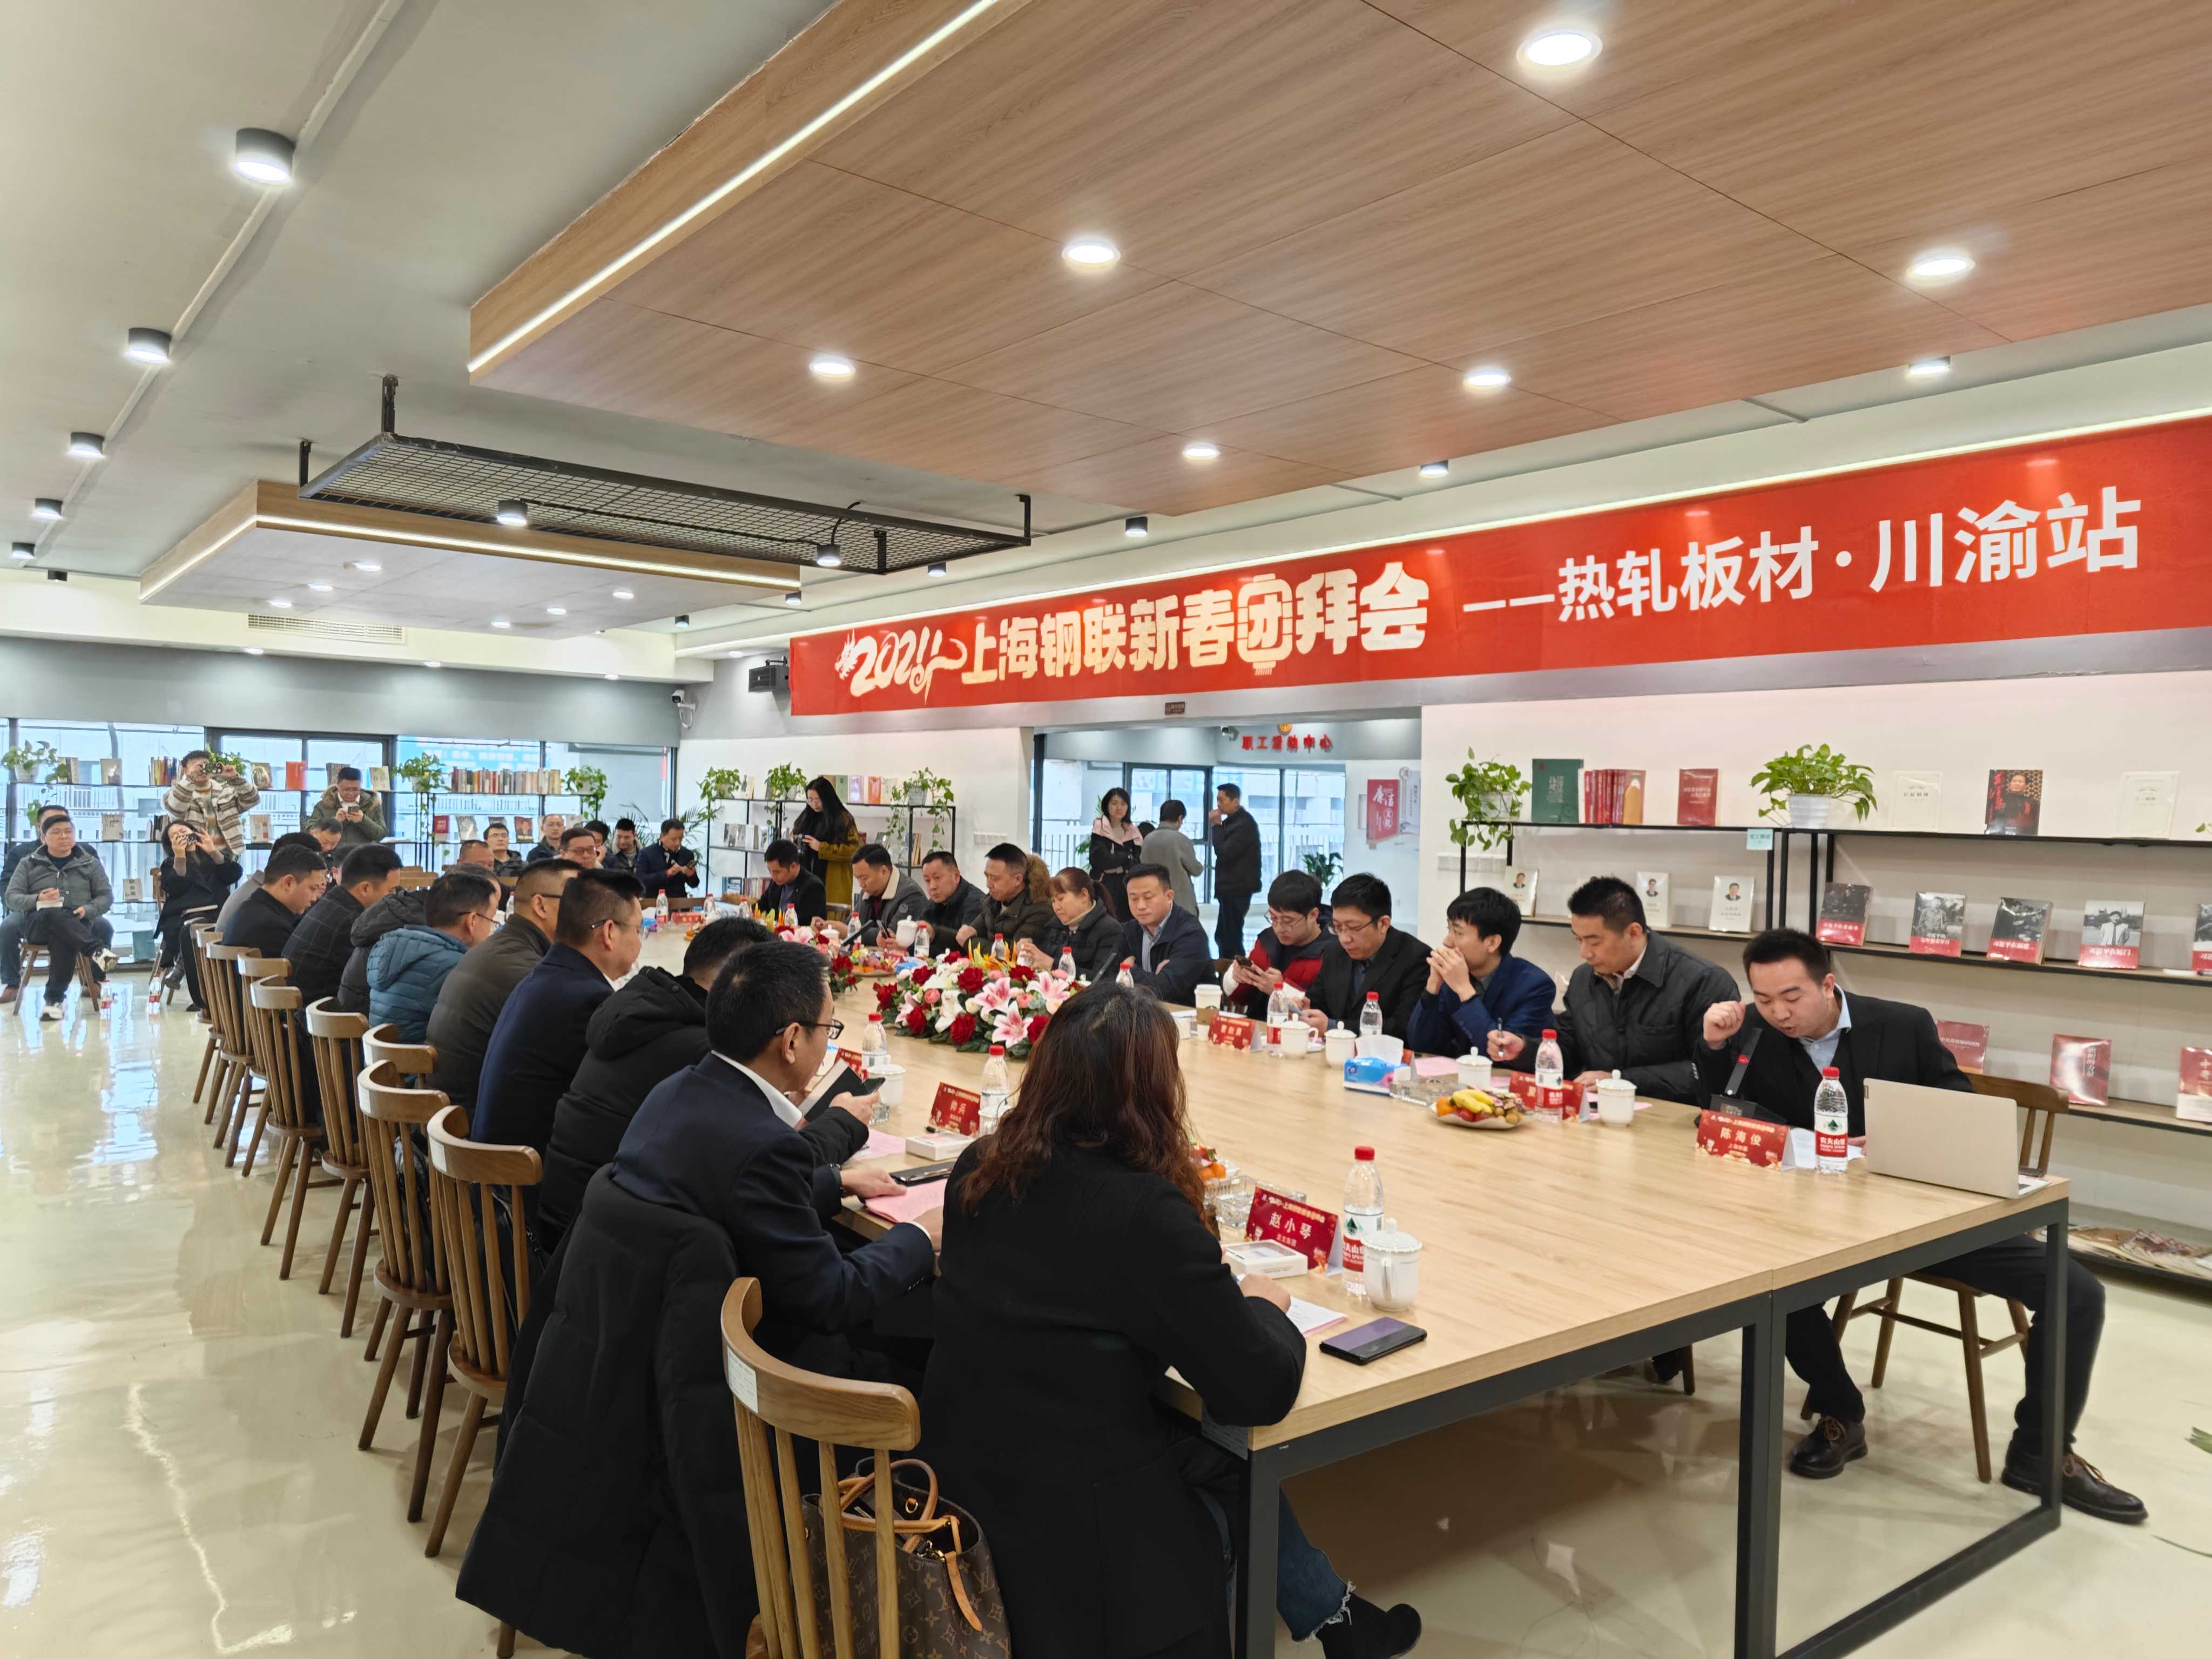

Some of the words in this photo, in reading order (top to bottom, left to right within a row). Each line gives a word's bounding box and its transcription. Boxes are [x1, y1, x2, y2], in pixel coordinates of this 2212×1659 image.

[961, 562, 1429, 685] 上海钢联新春团拜会
[1269, 1211, 1312, 1240] 赵小琴
